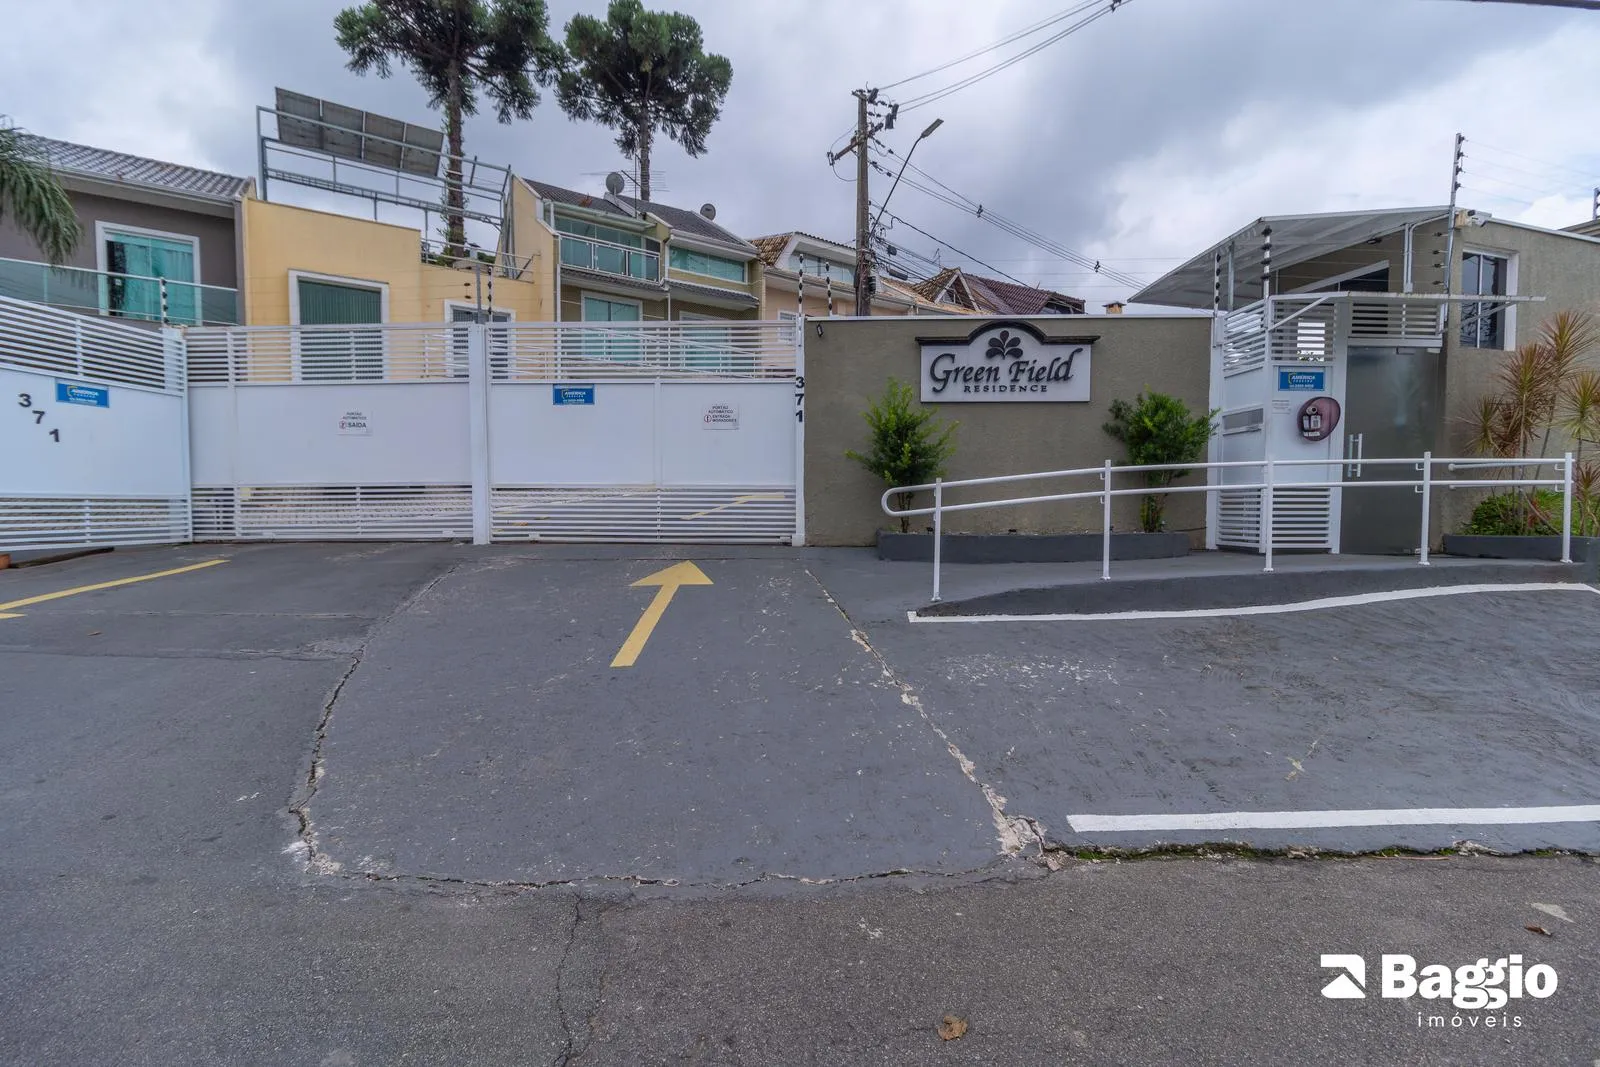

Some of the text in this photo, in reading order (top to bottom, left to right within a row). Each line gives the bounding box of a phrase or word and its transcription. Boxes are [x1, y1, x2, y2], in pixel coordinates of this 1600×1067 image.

[930, 348, 1083, 393] Green Field
[964, 385, 1047, 393] RESIDENCE
